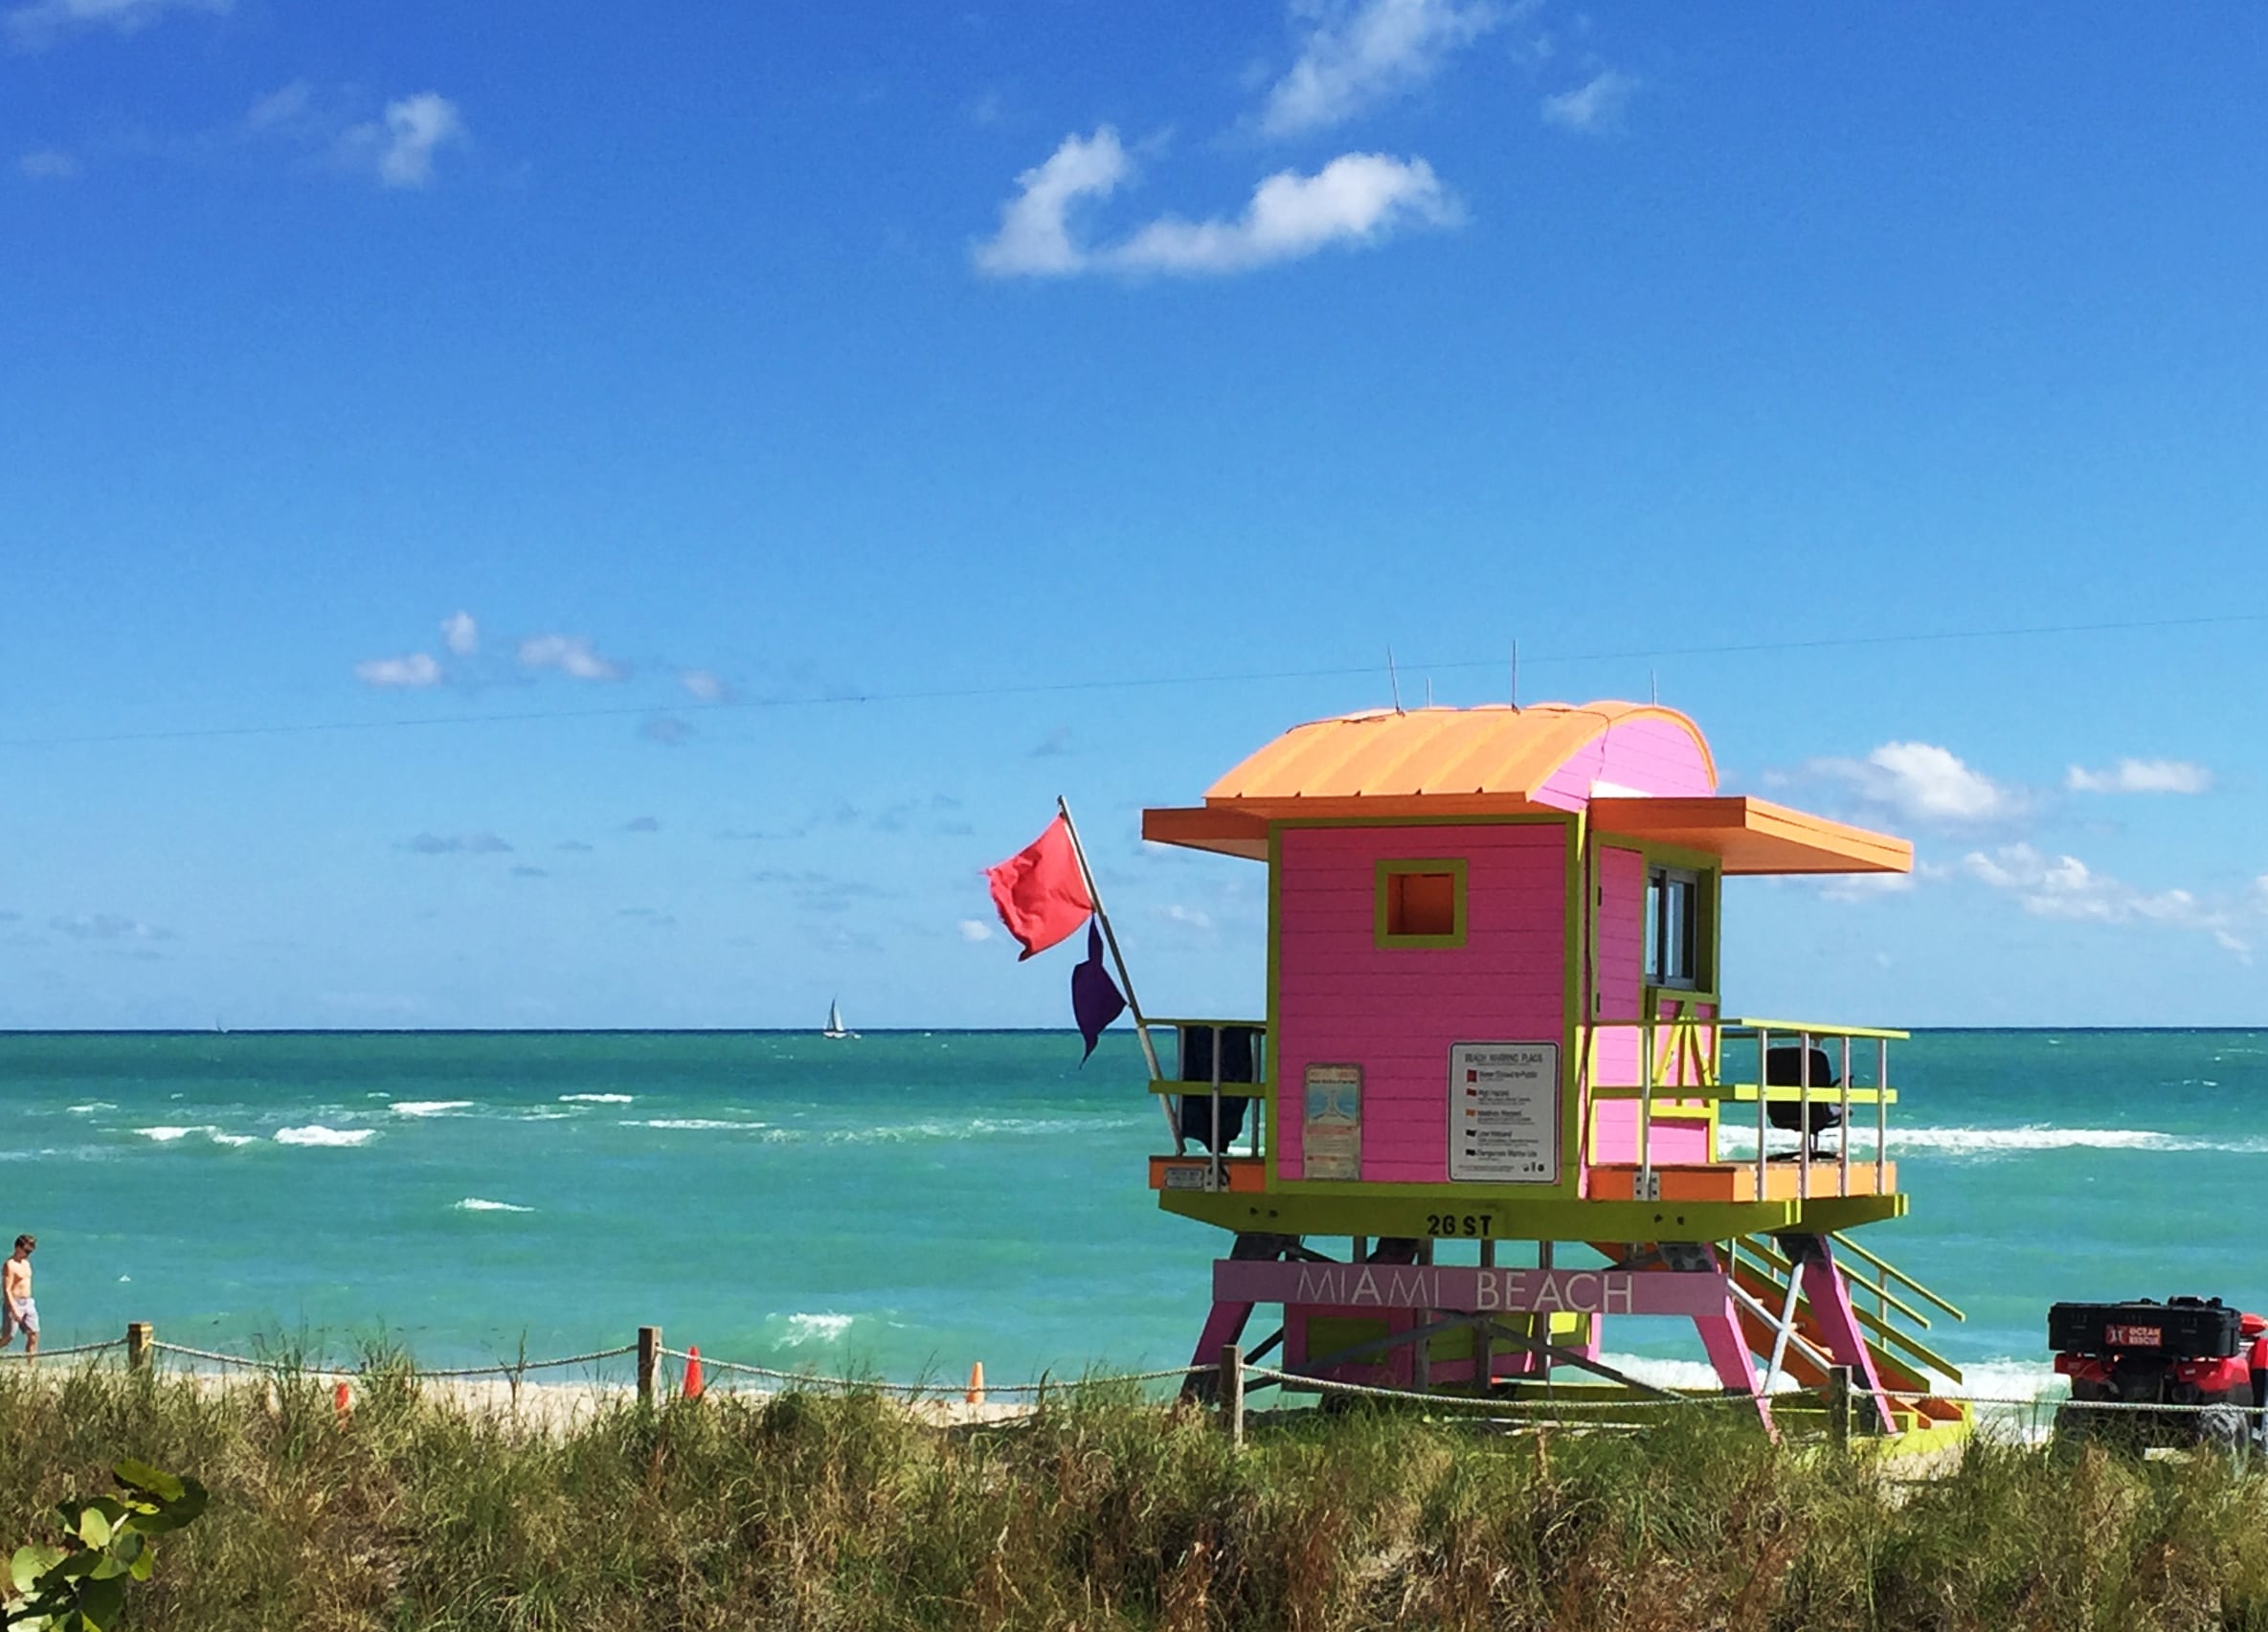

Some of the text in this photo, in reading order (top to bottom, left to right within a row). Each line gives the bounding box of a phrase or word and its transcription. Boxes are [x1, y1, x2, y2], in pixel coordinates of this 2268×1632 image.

[1463, 1215, 1493, 1237] ST
[1296, 1264, 1632, 1314] MIAMI BEACH
